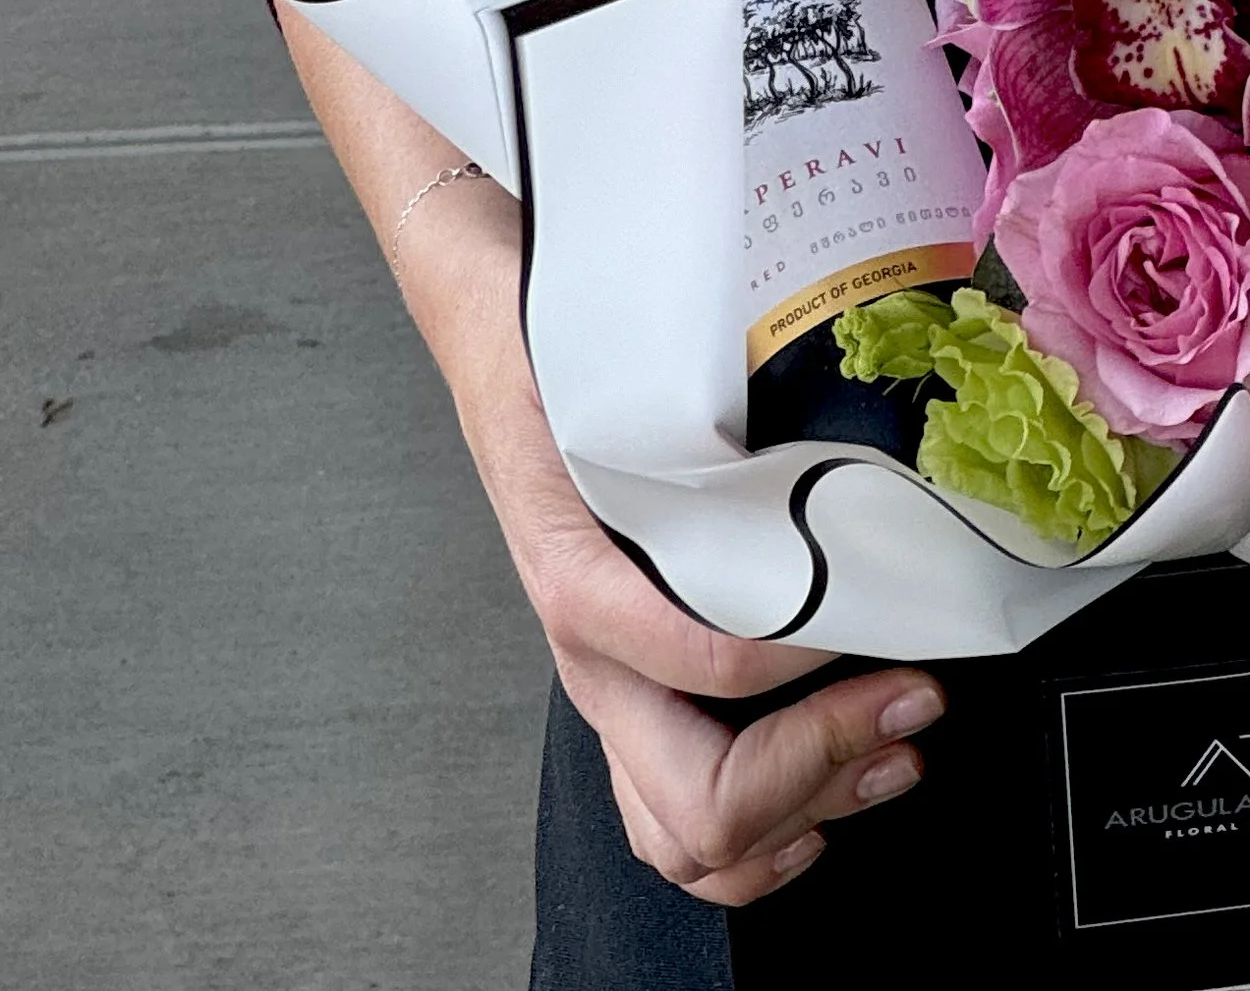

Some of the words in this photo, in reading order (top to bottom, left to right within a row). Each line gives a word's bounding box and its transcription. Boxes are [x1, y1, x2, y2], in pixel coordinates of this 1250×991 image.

[743, 137, 907, 215] PERAVI
[750, 260, 786, 291] RED
[769, 291, 827, 337] PRODUCT
[830, 282, 849, 299] OF
[851, 261, 918, 290] GEORGIA
[1165, 822, 1239, 839] FLORAL
